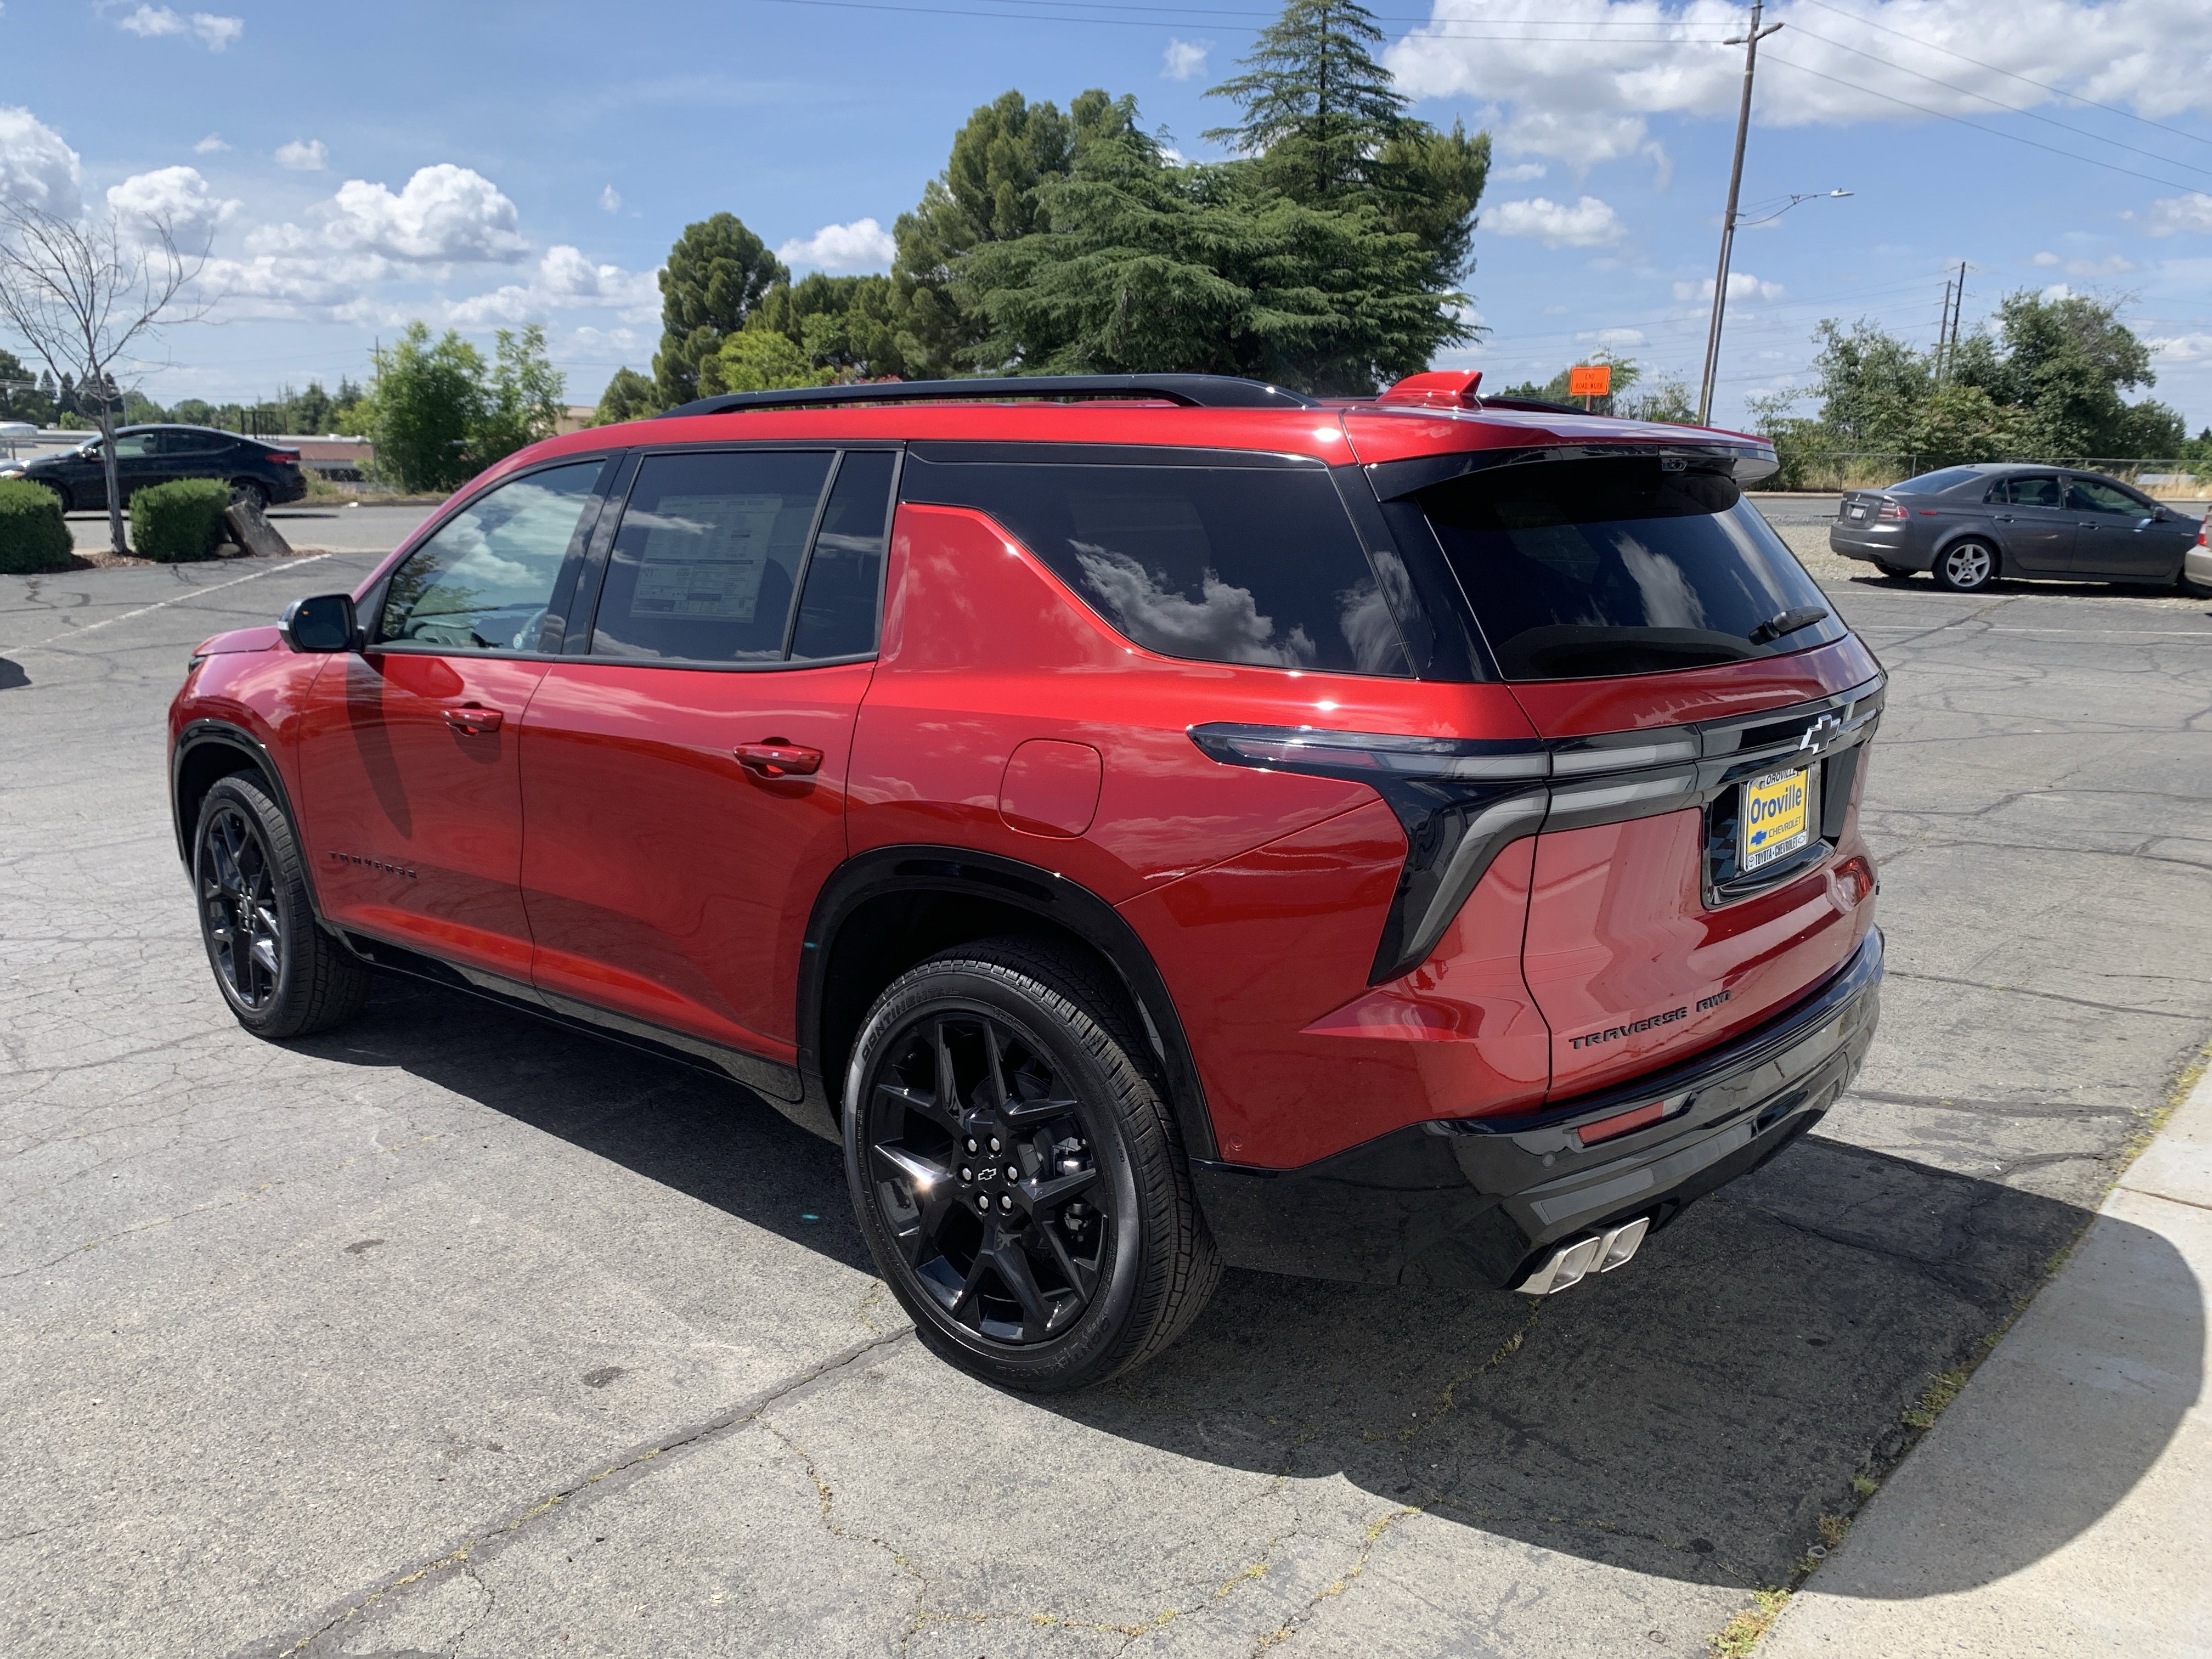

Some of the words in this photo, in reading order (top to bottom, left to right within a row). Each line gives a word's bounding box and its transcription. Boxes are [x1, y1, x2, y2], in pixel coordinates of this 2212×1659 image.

[1766, 769, 1797, 786] OROVILLE
[1750, 783, 1802, 825] Oroville
[1768, 816, 1802, 838] CHEVROLET
[1754, 848, 1772, 866] TOYOTA
[1775, 836, 1798, 857] CHEVROLET
[861, 985, 960, 1063] CONTINENTAL
[1569, 1006, 1688, 1049] TRAVERSE
[1696, 990, 1732, 1013] AWD
